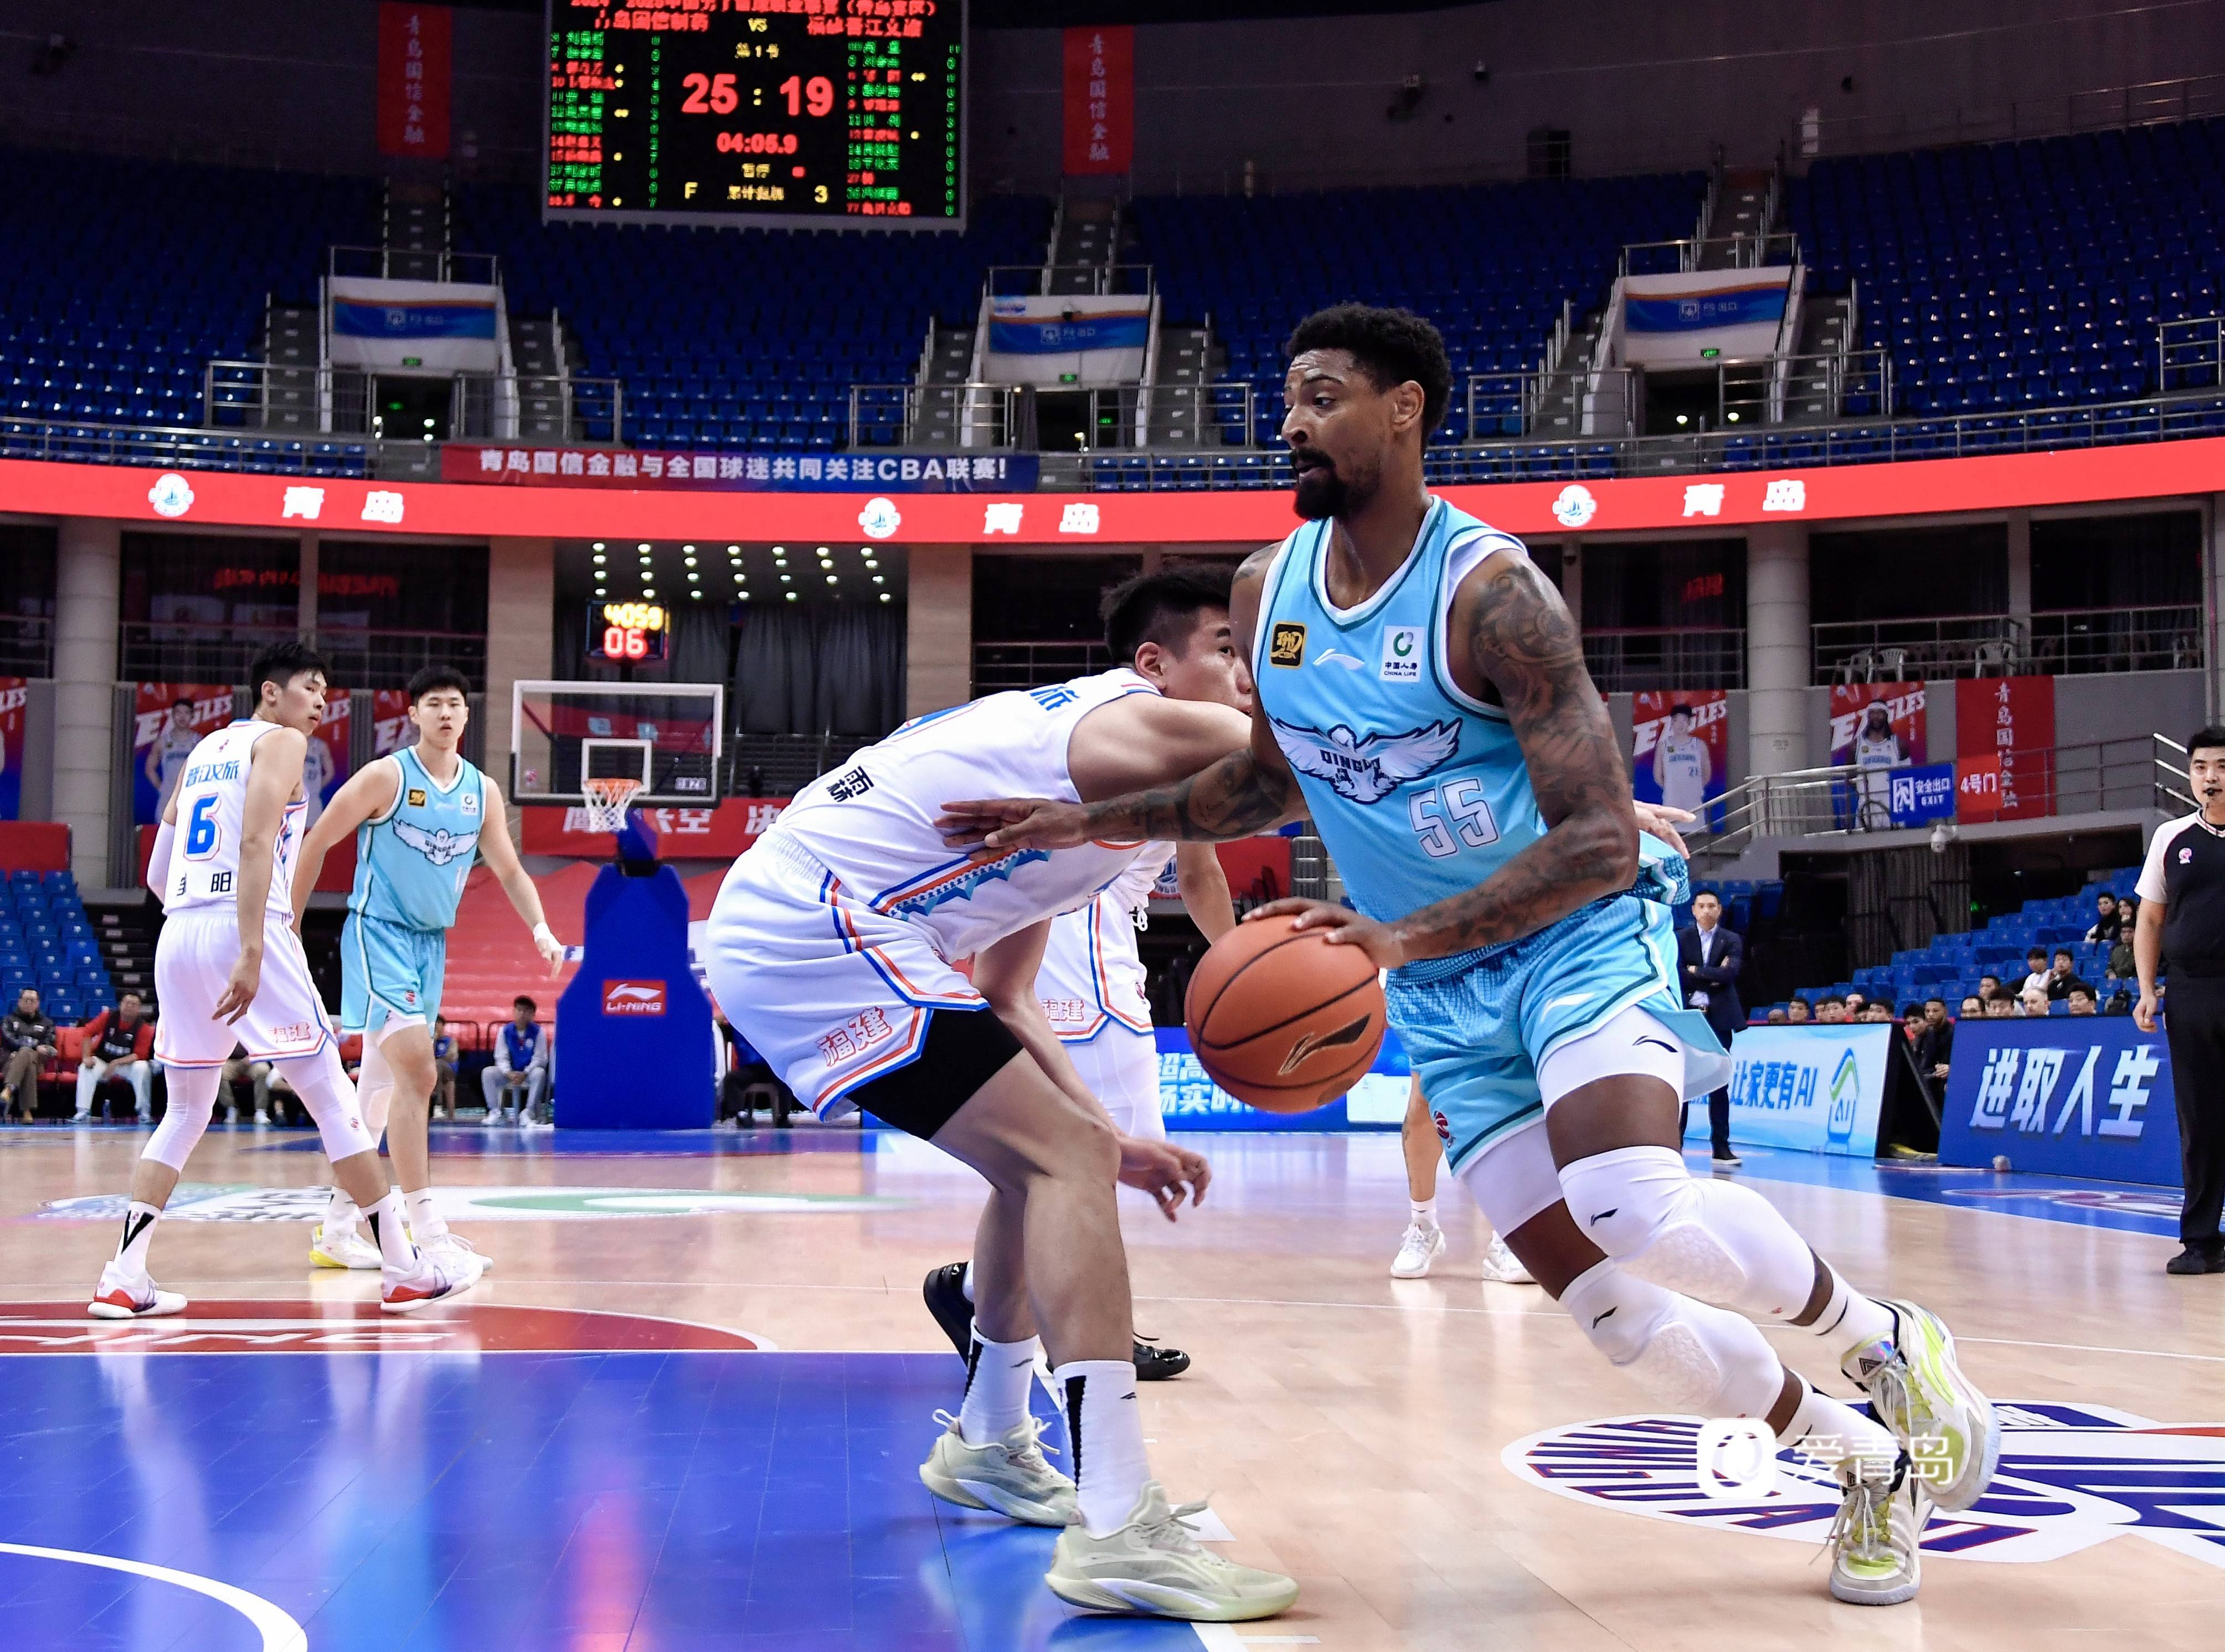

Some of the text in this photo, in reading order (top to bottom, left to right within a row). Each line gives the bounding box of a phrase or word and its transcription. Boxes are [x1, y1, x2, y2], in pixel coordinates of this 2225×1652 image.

[682, 73, 738, 115] 25
[779, 75, 833, 116] 19
[815, 185, 828, 203] 3
[605, 627, 648, 658] 06
[1915, 778, 1951, 794] 安全出口
[1960, 772, 1997, 795] 4号门
[184, 792, 222, 861] 6
[1408, 778, 1498, 858] 55
[605, 1002, 662, 1013] LI-NING
[815, 1006, 893, 1067] 福建
[1969, 1045, 2159, 1137] 进取人生
